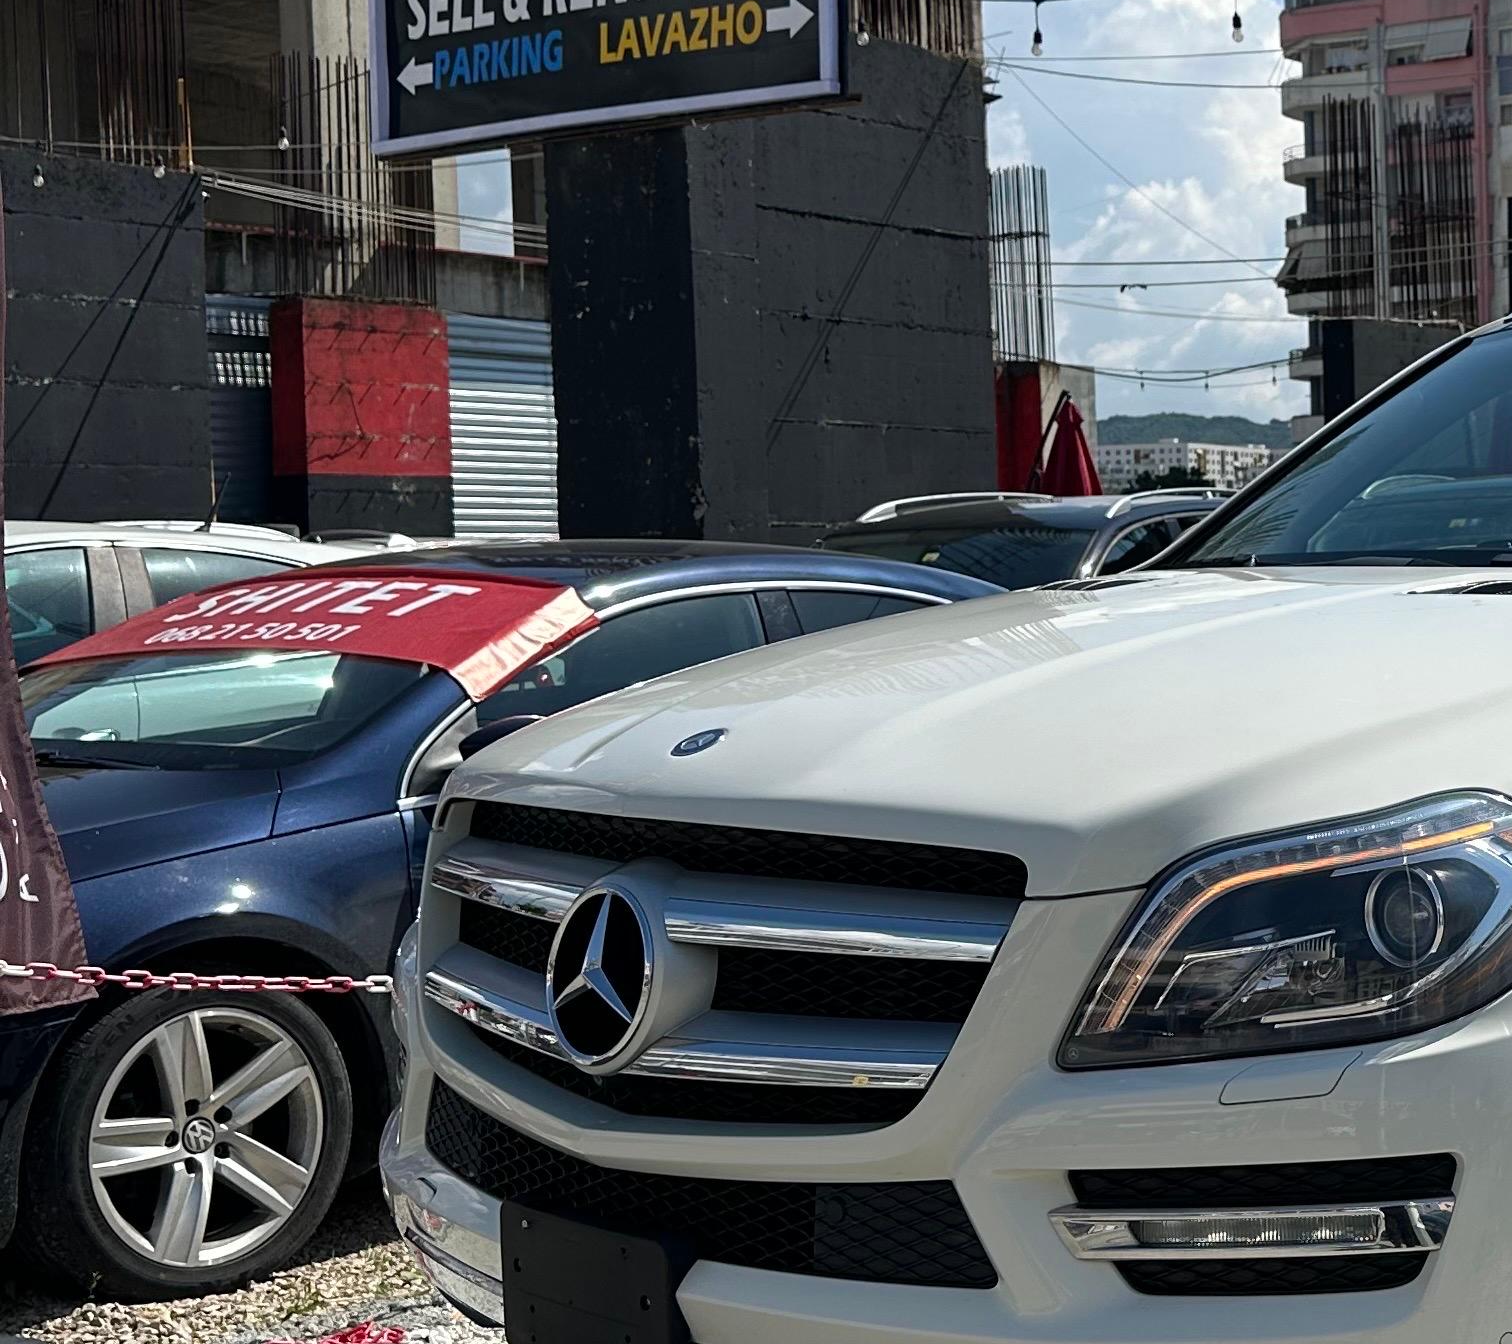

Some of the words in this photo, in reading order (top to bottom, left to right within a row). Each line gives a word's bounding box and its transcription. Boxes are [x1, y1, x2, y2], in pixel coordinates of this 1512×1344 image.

[434, 30, 563, 90] PARKING
[600, 0, 763, 64] LAVAZHO
[164, 581, 482, 623] SHITET
